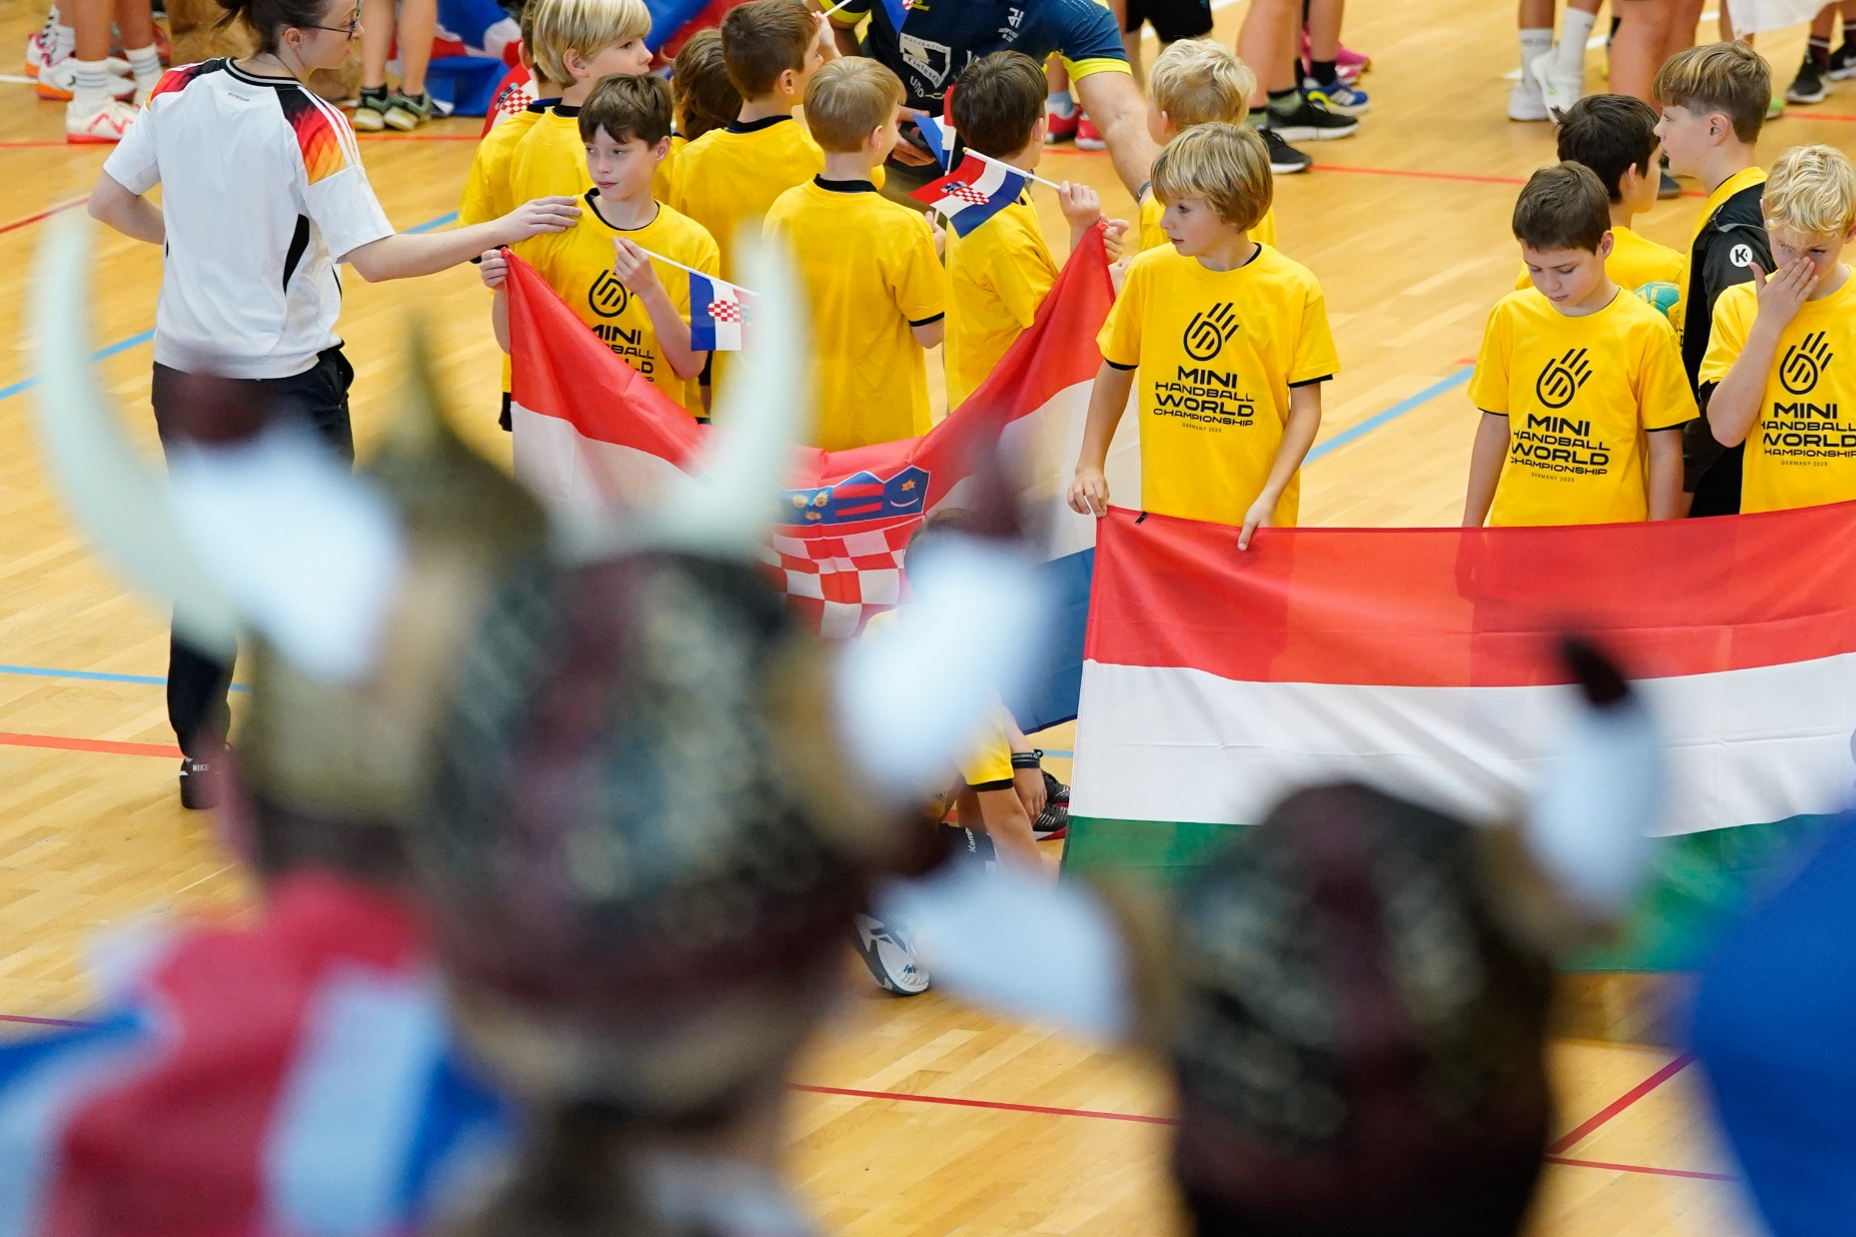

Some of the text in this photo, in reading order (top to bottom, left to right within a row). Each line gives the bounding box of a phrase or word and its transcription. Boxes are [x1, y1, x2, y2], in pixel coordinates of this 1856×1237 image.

[1177, 365, 1238, 389] MINI
[1154, 381, 1255, 403] HANDBALL
[1153, 408, 1254, 427] CHAMPIONSHIP
[1154, 393, 1255, 418] WORLD
[1773, 402, 1838, 420] MINI
[1527, 412, 1591, 437] MINI
[1511, 440, 1610, 467] WORLD
